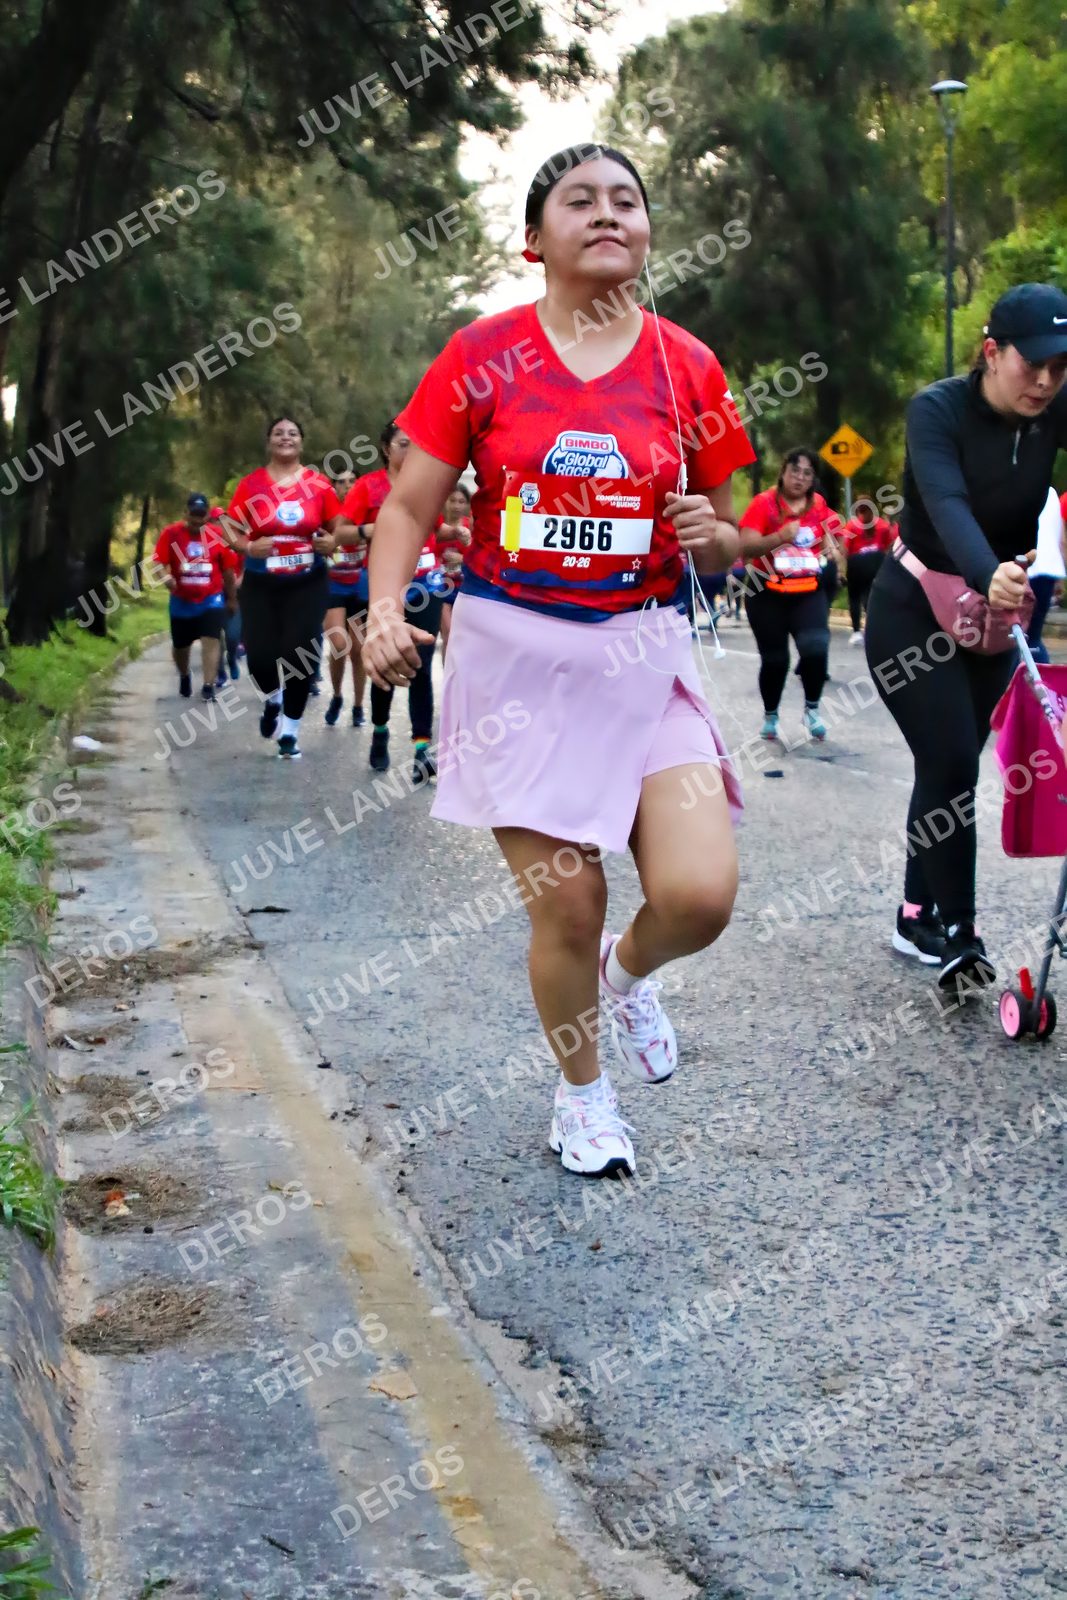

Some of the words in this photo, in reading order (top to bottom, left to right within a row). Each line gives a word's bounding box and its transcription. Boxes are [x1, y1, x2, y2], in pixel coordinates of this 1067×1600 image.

[565, 438, 609, 450] BIMBO
[564, 452, 608, 468] Global
[556, 465, 590, 477] Race
[543, 517, 613, 552] 2966
[562, 555, 590, 568] 20-26
[622, 573, 635, 582] 5K
